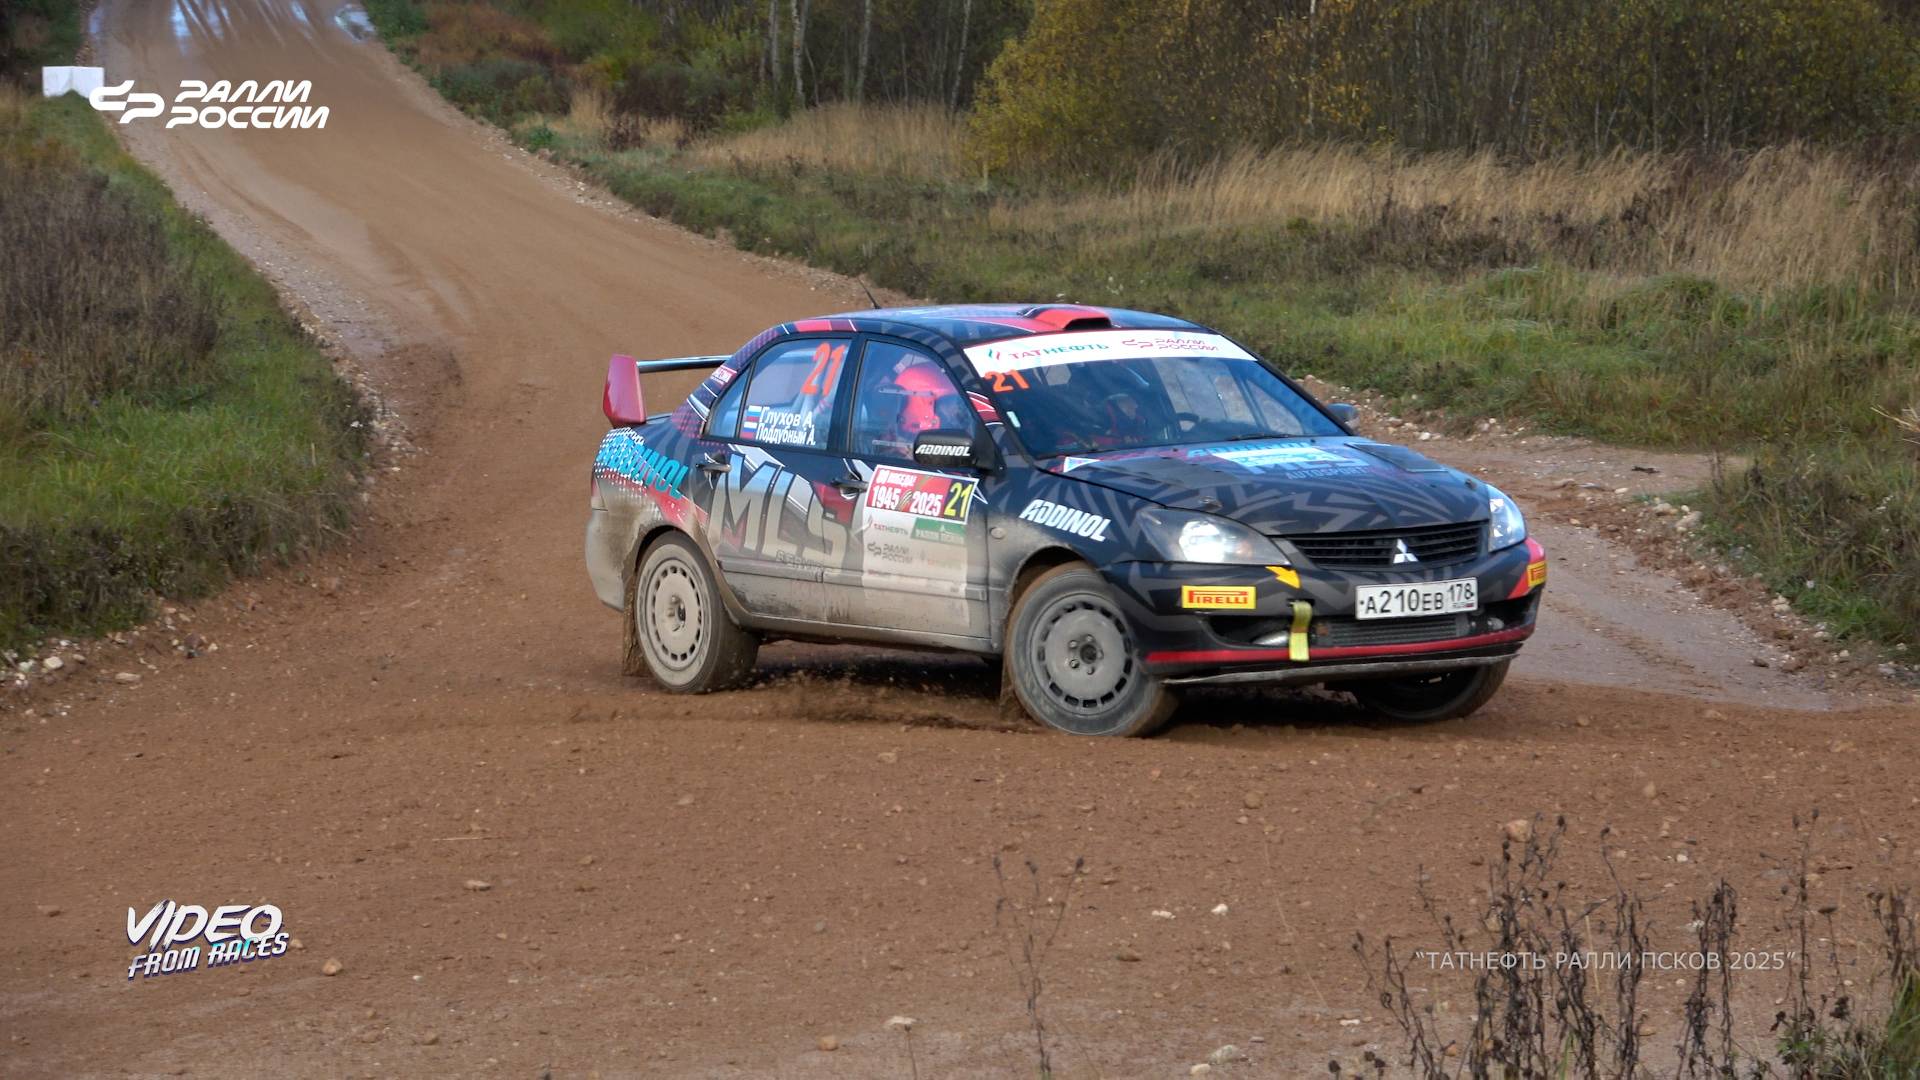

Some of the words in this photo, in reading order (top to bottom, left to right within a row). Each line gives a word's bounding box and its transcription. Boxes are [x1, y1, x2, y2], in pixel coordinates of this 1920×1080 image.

[1009, 344, 1109, 360] ТАТНЕФТЬ
[803, 343, 845, 396] 21
[985, 369, 1030, 392] 21
[760, 406, 801, 427] Глухов
[756, 423, 806, 445] Поддубный
[915, 444, 970, 456] ADDINOL
[1286, 466, 1369, 480] AUTOSPORT
[872, 486, 901, 510] 1945
[910, 491, 943, 516] 2025
[944, 482, 972, 517] 21
[707, 453, 847, 576] MLS
[1018, 498, 1111, 542] ADDINOL
[1188, 590, 1248, 604] PIRELLI
[1450, 583, 1474, 601] 178
